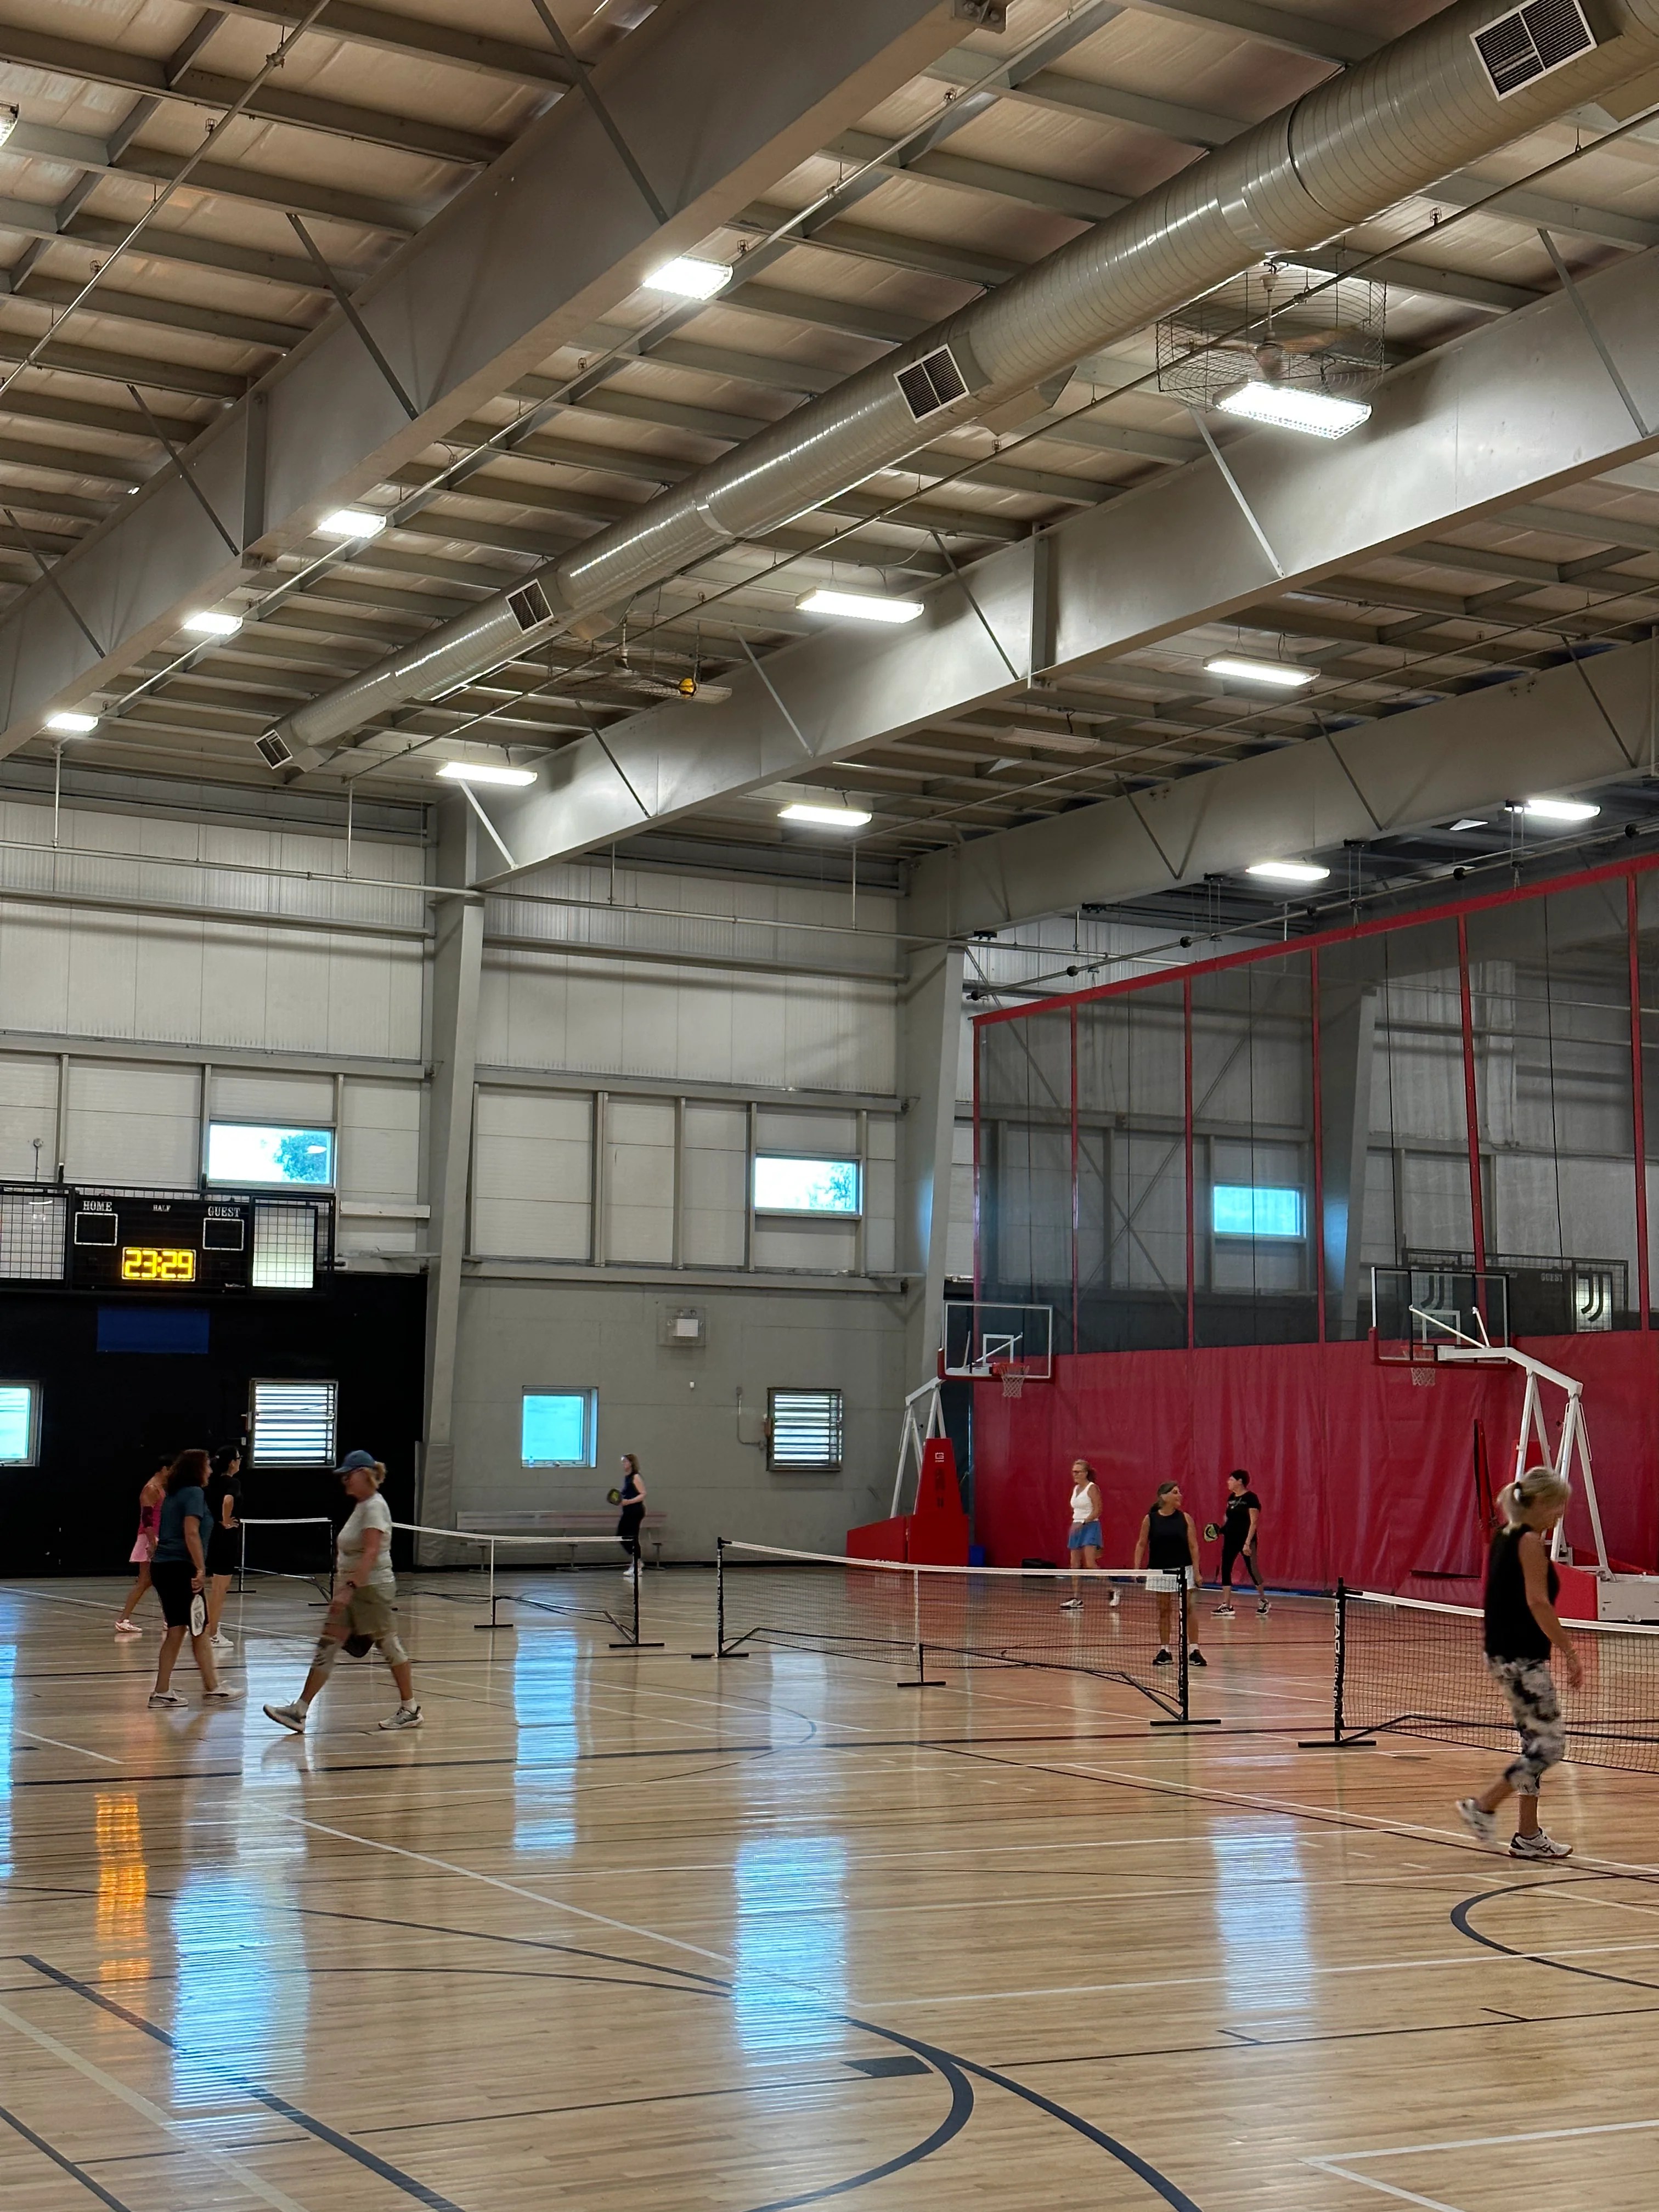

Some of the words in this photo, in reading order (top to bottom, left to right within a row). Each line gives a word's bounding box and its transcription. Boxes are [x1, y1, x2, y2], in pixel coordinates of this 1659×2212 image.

[83, 1200, 112, 1211] HOME
[208, 1206, 240, 1217] GUEST
[125, 1250, 193, 1278] 23:29
